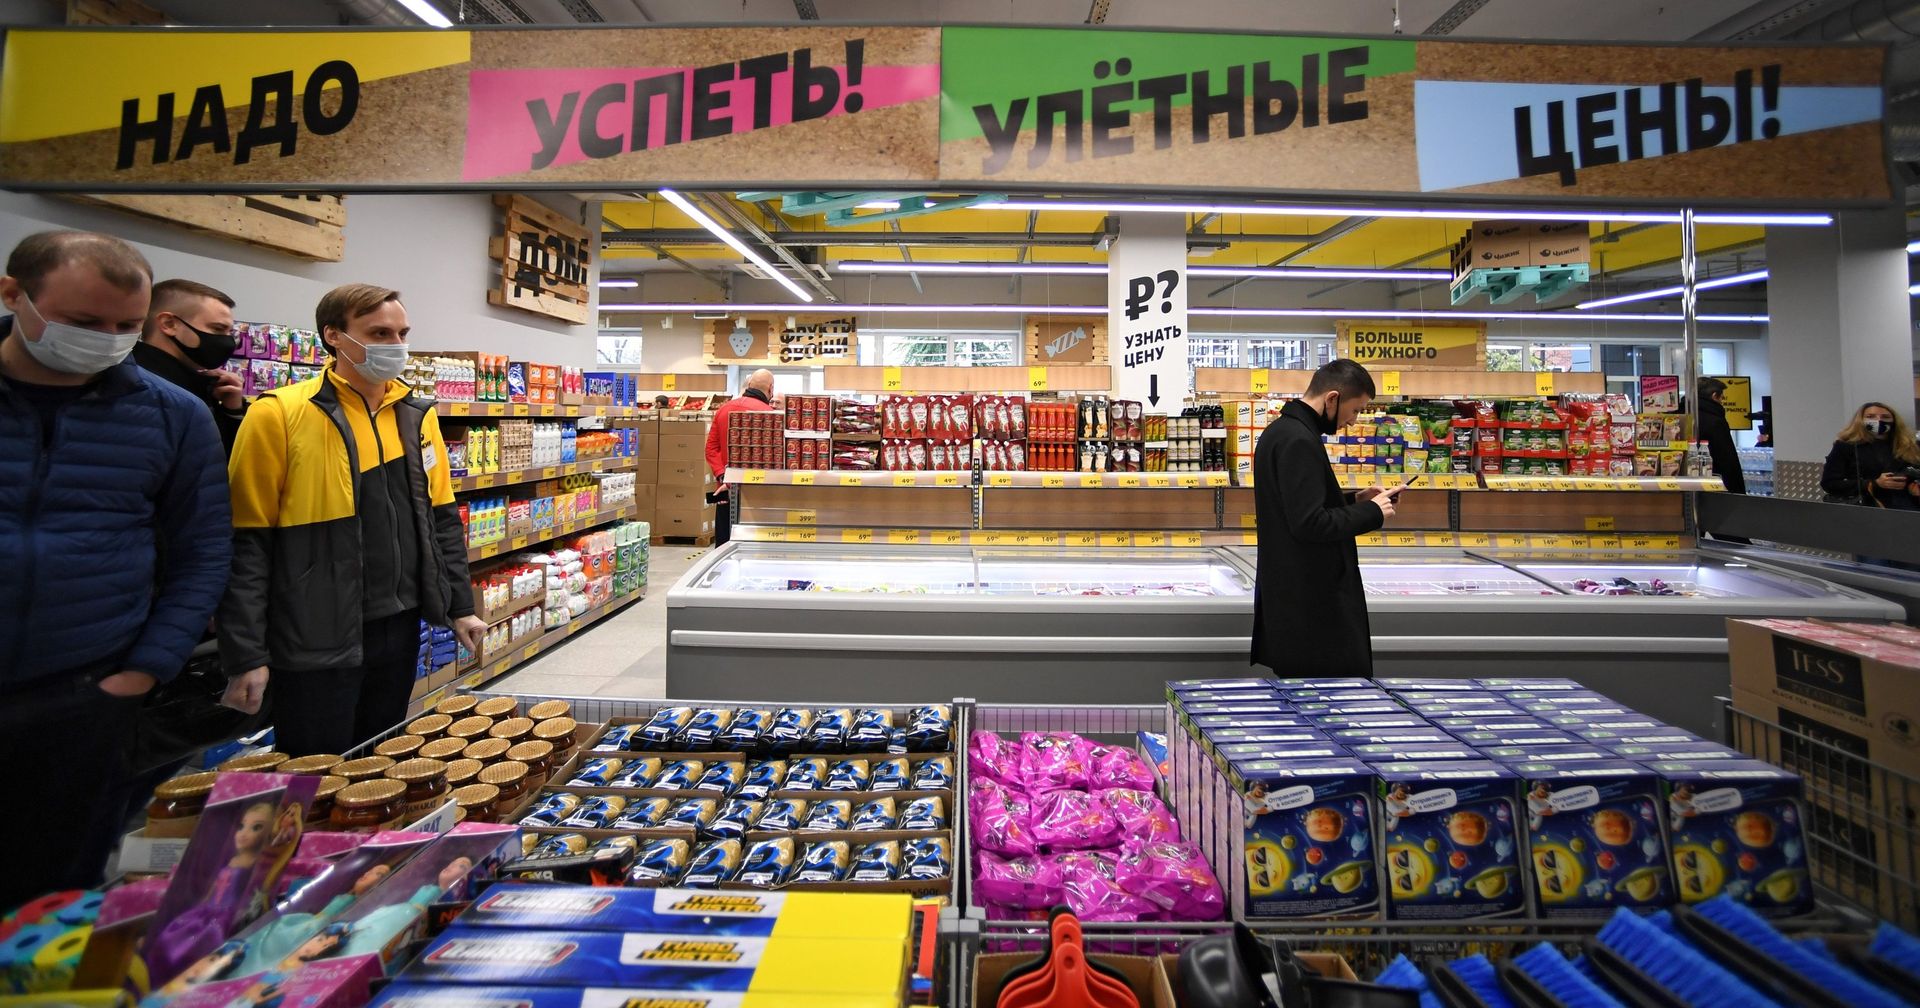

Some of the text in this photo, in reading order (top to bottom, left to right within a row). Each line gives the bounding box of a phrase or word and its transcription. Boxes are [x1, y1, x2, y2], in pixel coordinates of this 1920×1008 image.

[116, 39, 866, 171] НАДО УСПЕТЬ!
[972, 45, 1782, 186] УЛЁТНЫЕ ЦЕНЫ!
[1124, 325, 1182, 349] УЗНАТЬ
[1354, 331, 1423, 345] БОЛЬШЕ
[1124, 346, 1165, 368] ЦЕНУ
[1354, 346, 1437, 359] НУЖНОГО
[1787, 647, 1845, 685] TESS
[686, 895, 761, 905] TURBO
[668, 902, 767, 913] TWISTER
[655, 940, 739, 952] TURBO
[635, 949, 745, 962] TWISTER
